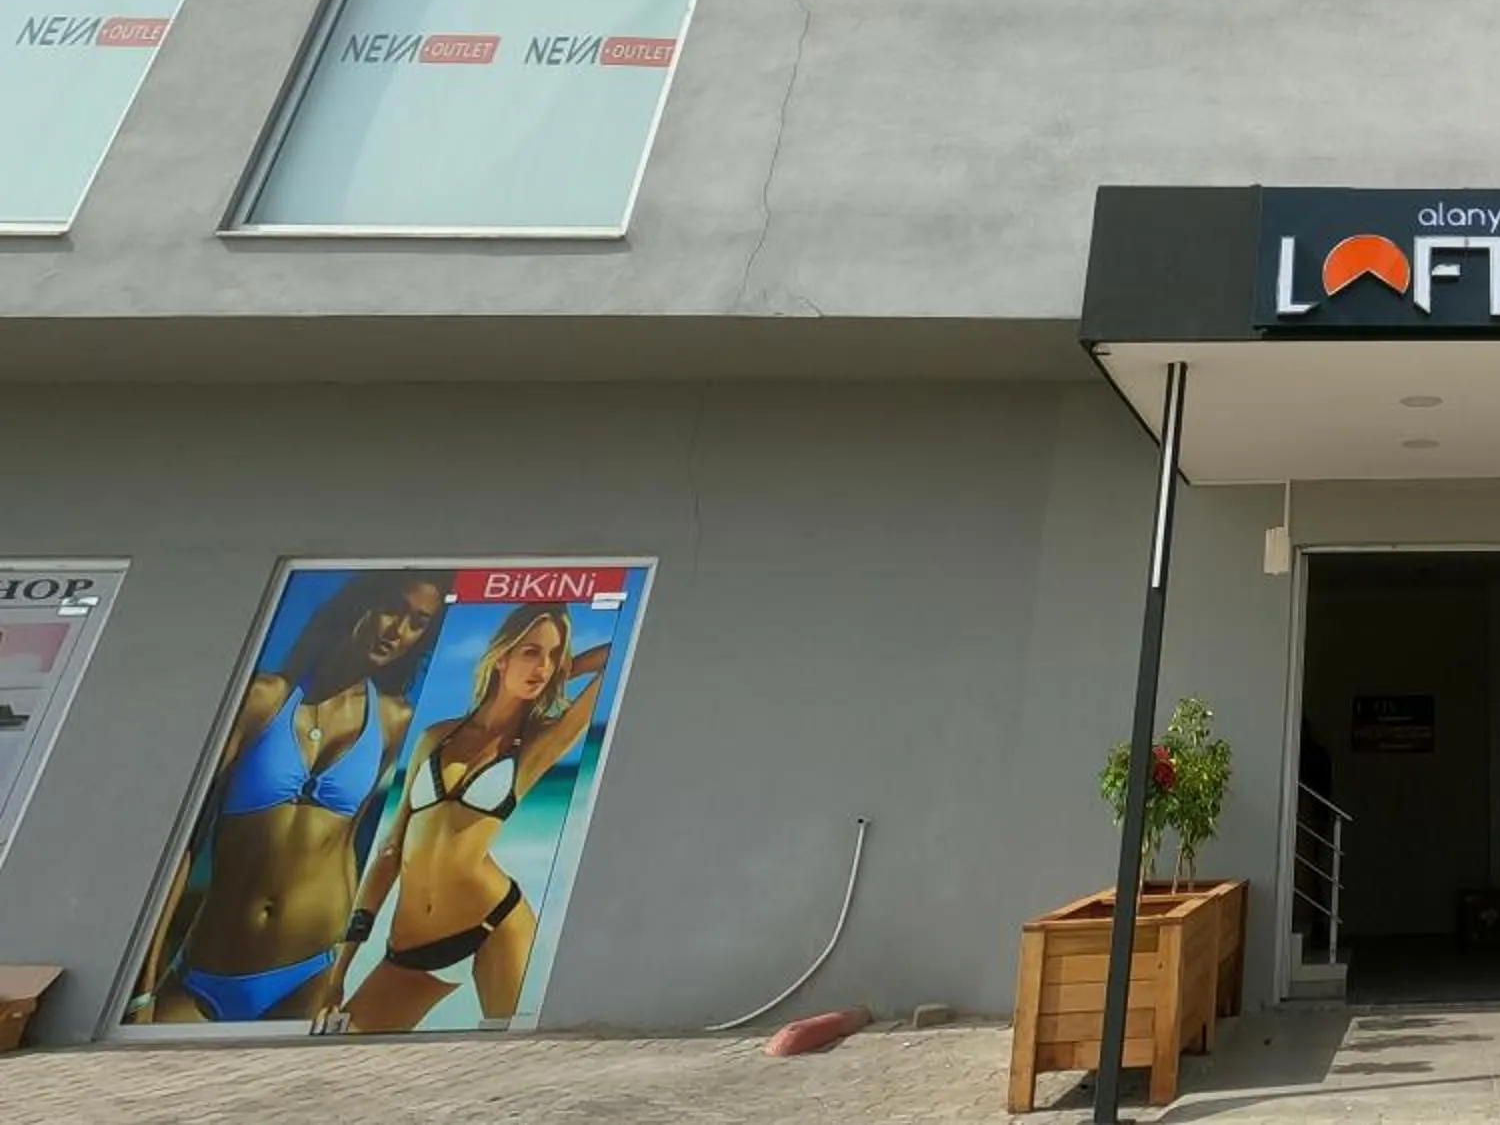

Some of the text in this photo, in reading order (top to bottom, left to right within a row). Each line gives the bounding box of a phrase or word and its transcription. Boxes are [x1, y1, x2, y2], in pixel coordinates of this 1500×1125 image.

[15, 17, 101, 46] NEVA
[341, 33, 494, 63] NEVA OUTLET
[525, 36, 673, 65] NEVA OUTLET
